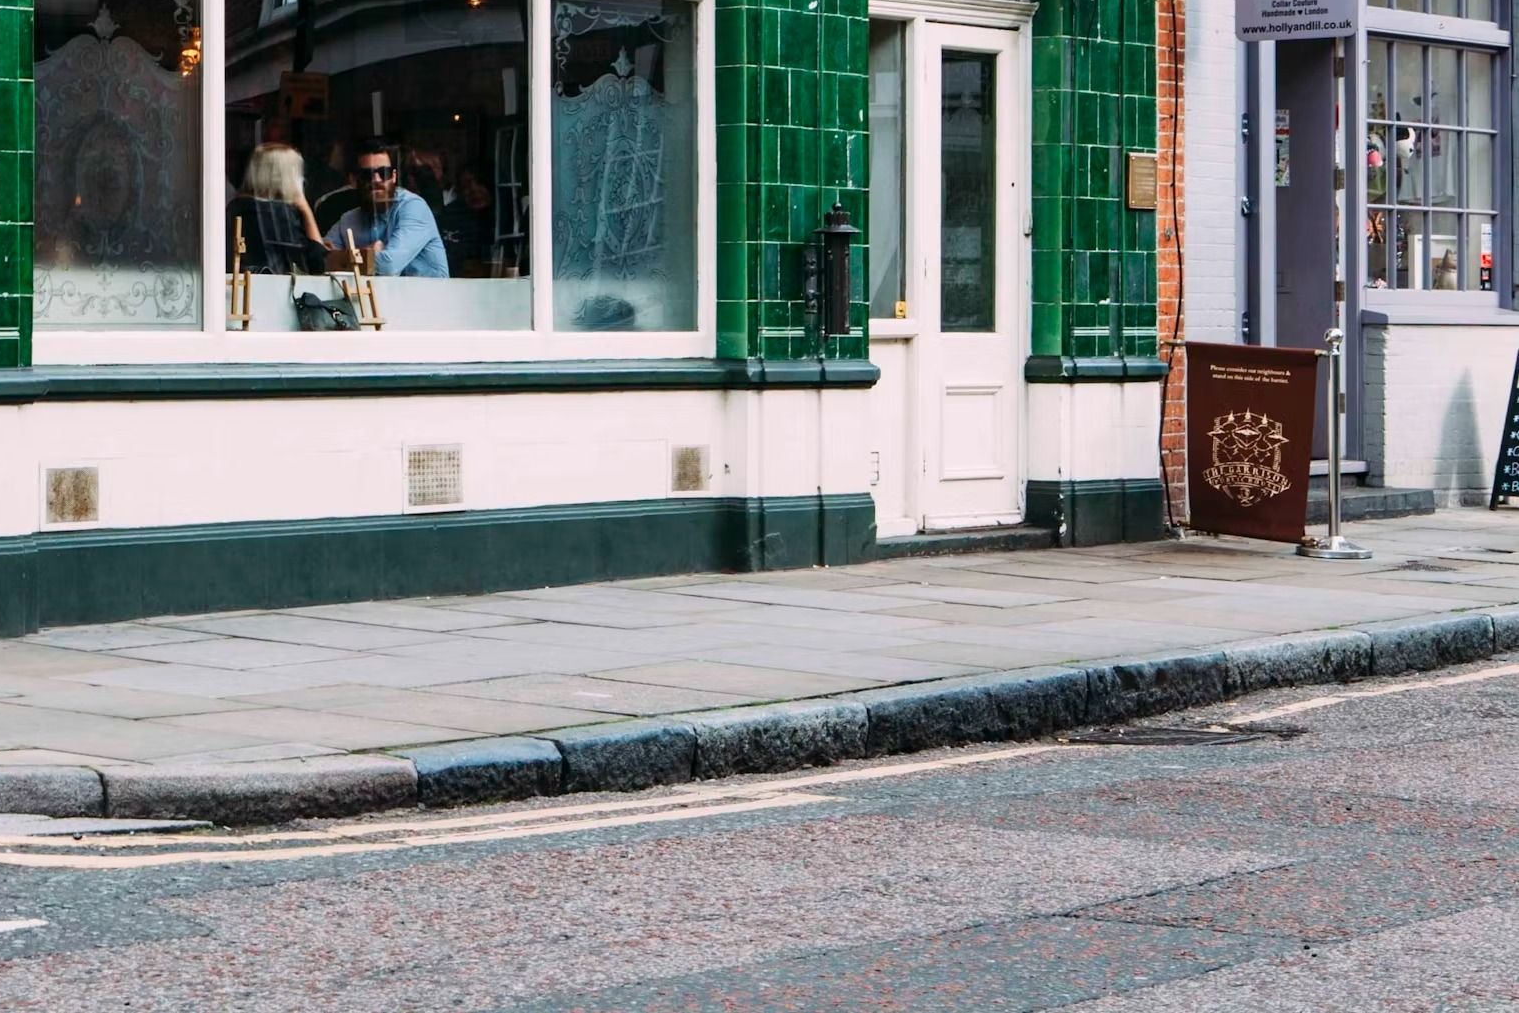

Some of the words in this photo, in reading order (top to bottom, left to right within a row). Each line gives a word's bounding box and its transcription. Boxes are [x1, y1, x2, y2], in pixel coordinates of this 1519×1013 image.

[1272, 0, 1291, 8] Collar
[1293, 0, 1318, 7] Couture
[1262, 9, 1296, 18] Handmade
[1304, 8, 1329, 16] London
[1242, 19, 1353, 34] www.hollyandlil.co.uk
[1228, 465, 1289, 487] GARRISON
